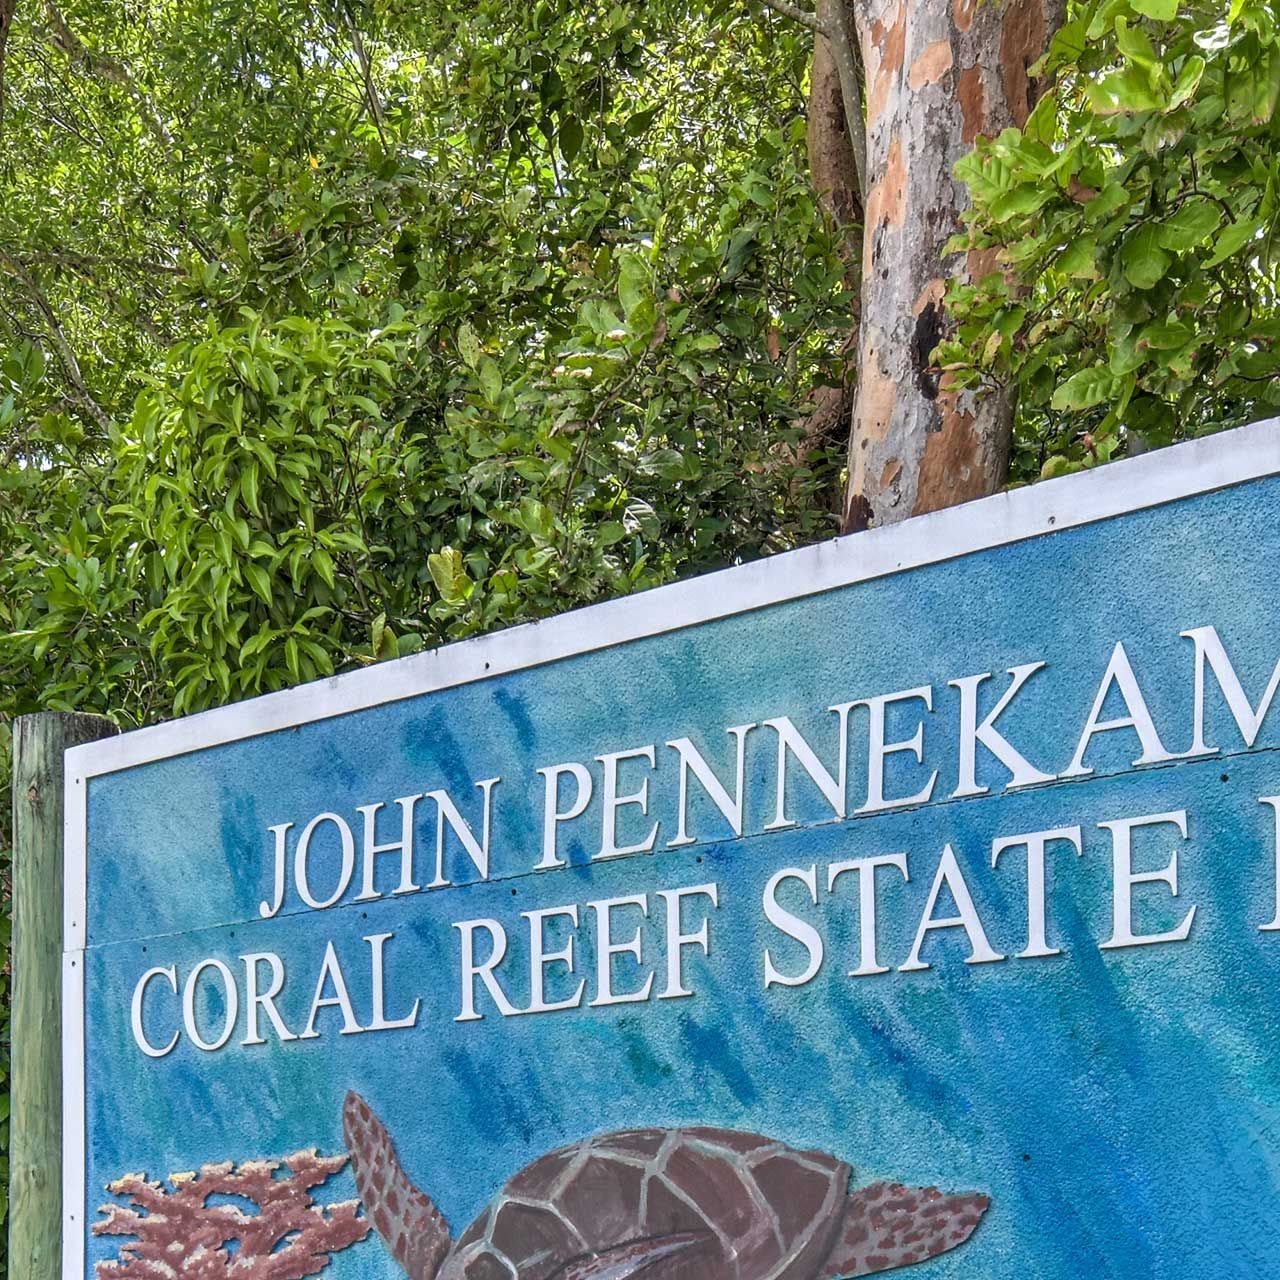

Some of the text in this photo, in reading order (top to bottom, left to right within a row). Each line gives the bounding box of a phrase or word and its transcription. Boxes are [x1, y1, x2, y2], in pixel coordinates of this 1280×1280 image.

[130, 932, 420, 1058] CORAL
[451, 883, 718, 1021] REEF
[763, 809, 1198, 987] STATE
[260, 776, 501, 919] JOHN
